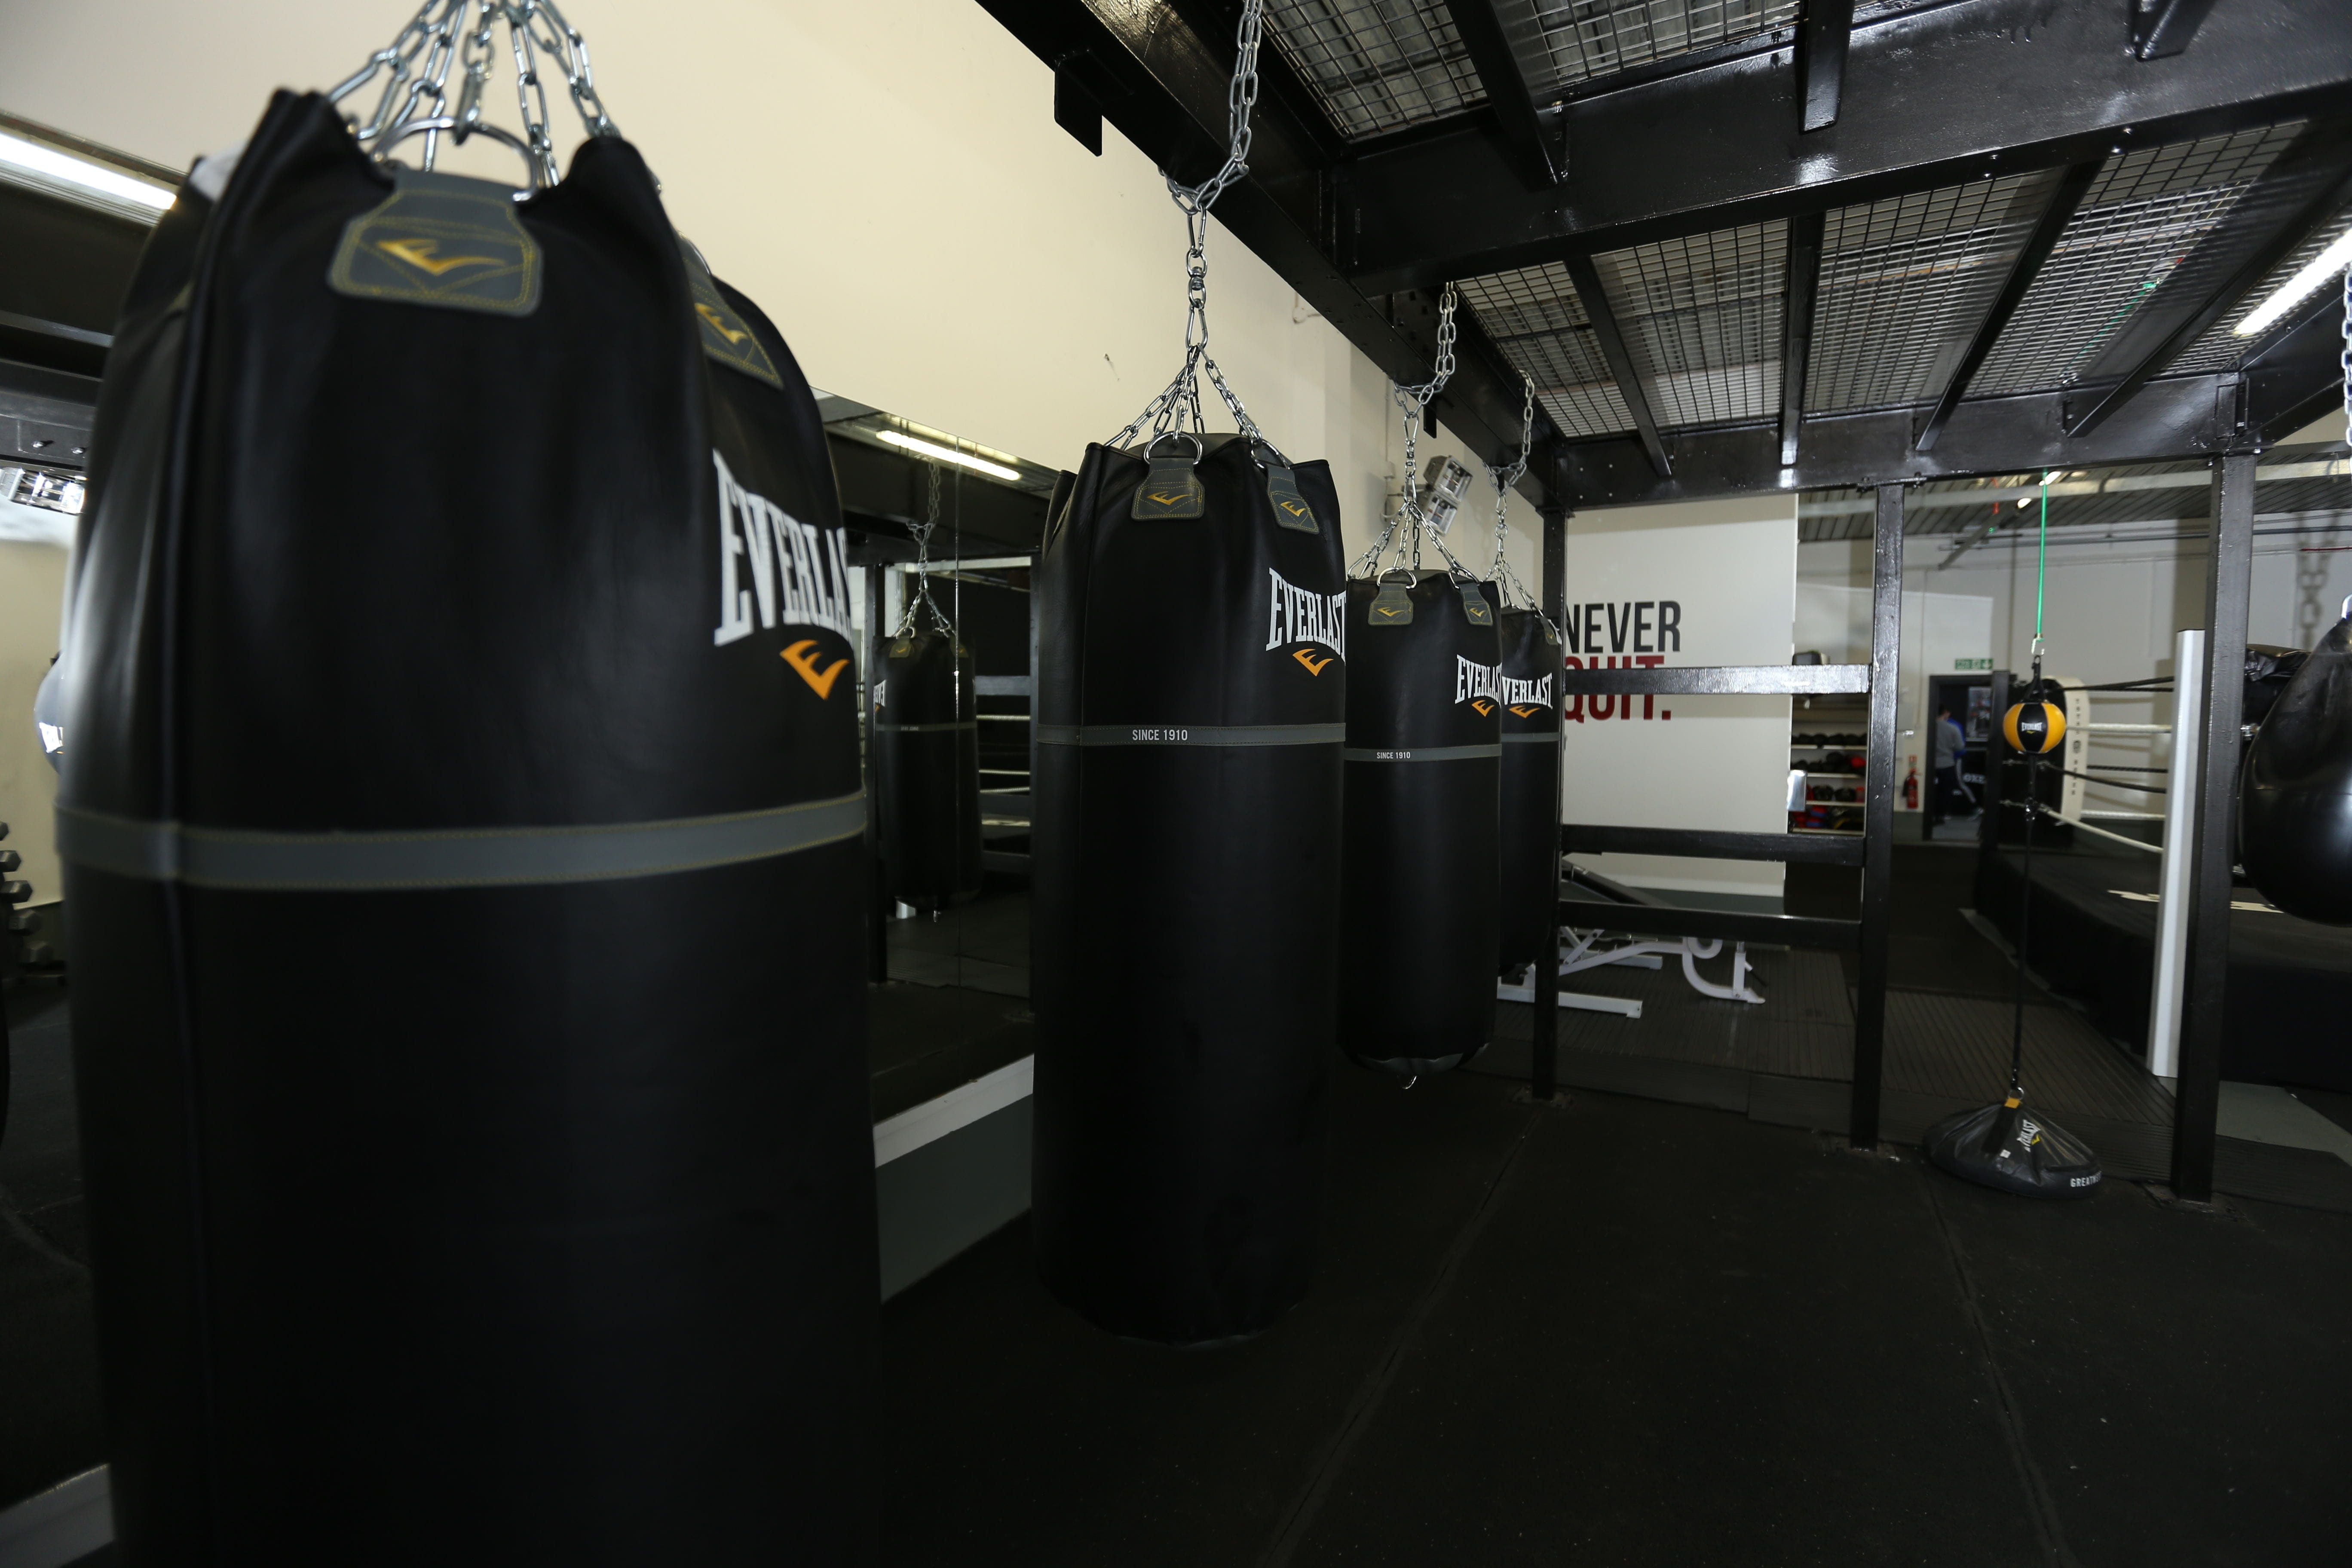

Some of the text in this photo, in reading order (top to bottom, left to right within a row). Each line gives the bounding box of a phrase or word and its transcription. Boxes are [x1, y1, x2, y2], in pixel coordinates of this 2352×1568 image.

[1266, 567, 1346, 665] EVERLAST
[1566, 600, 1681, 654] NEVER
[1455, 654, 1502, 709] EVERLAST
[1502, 673, 1553, 709] VERLAST
[1133, 729, 1188, 741] SINCE 1910
